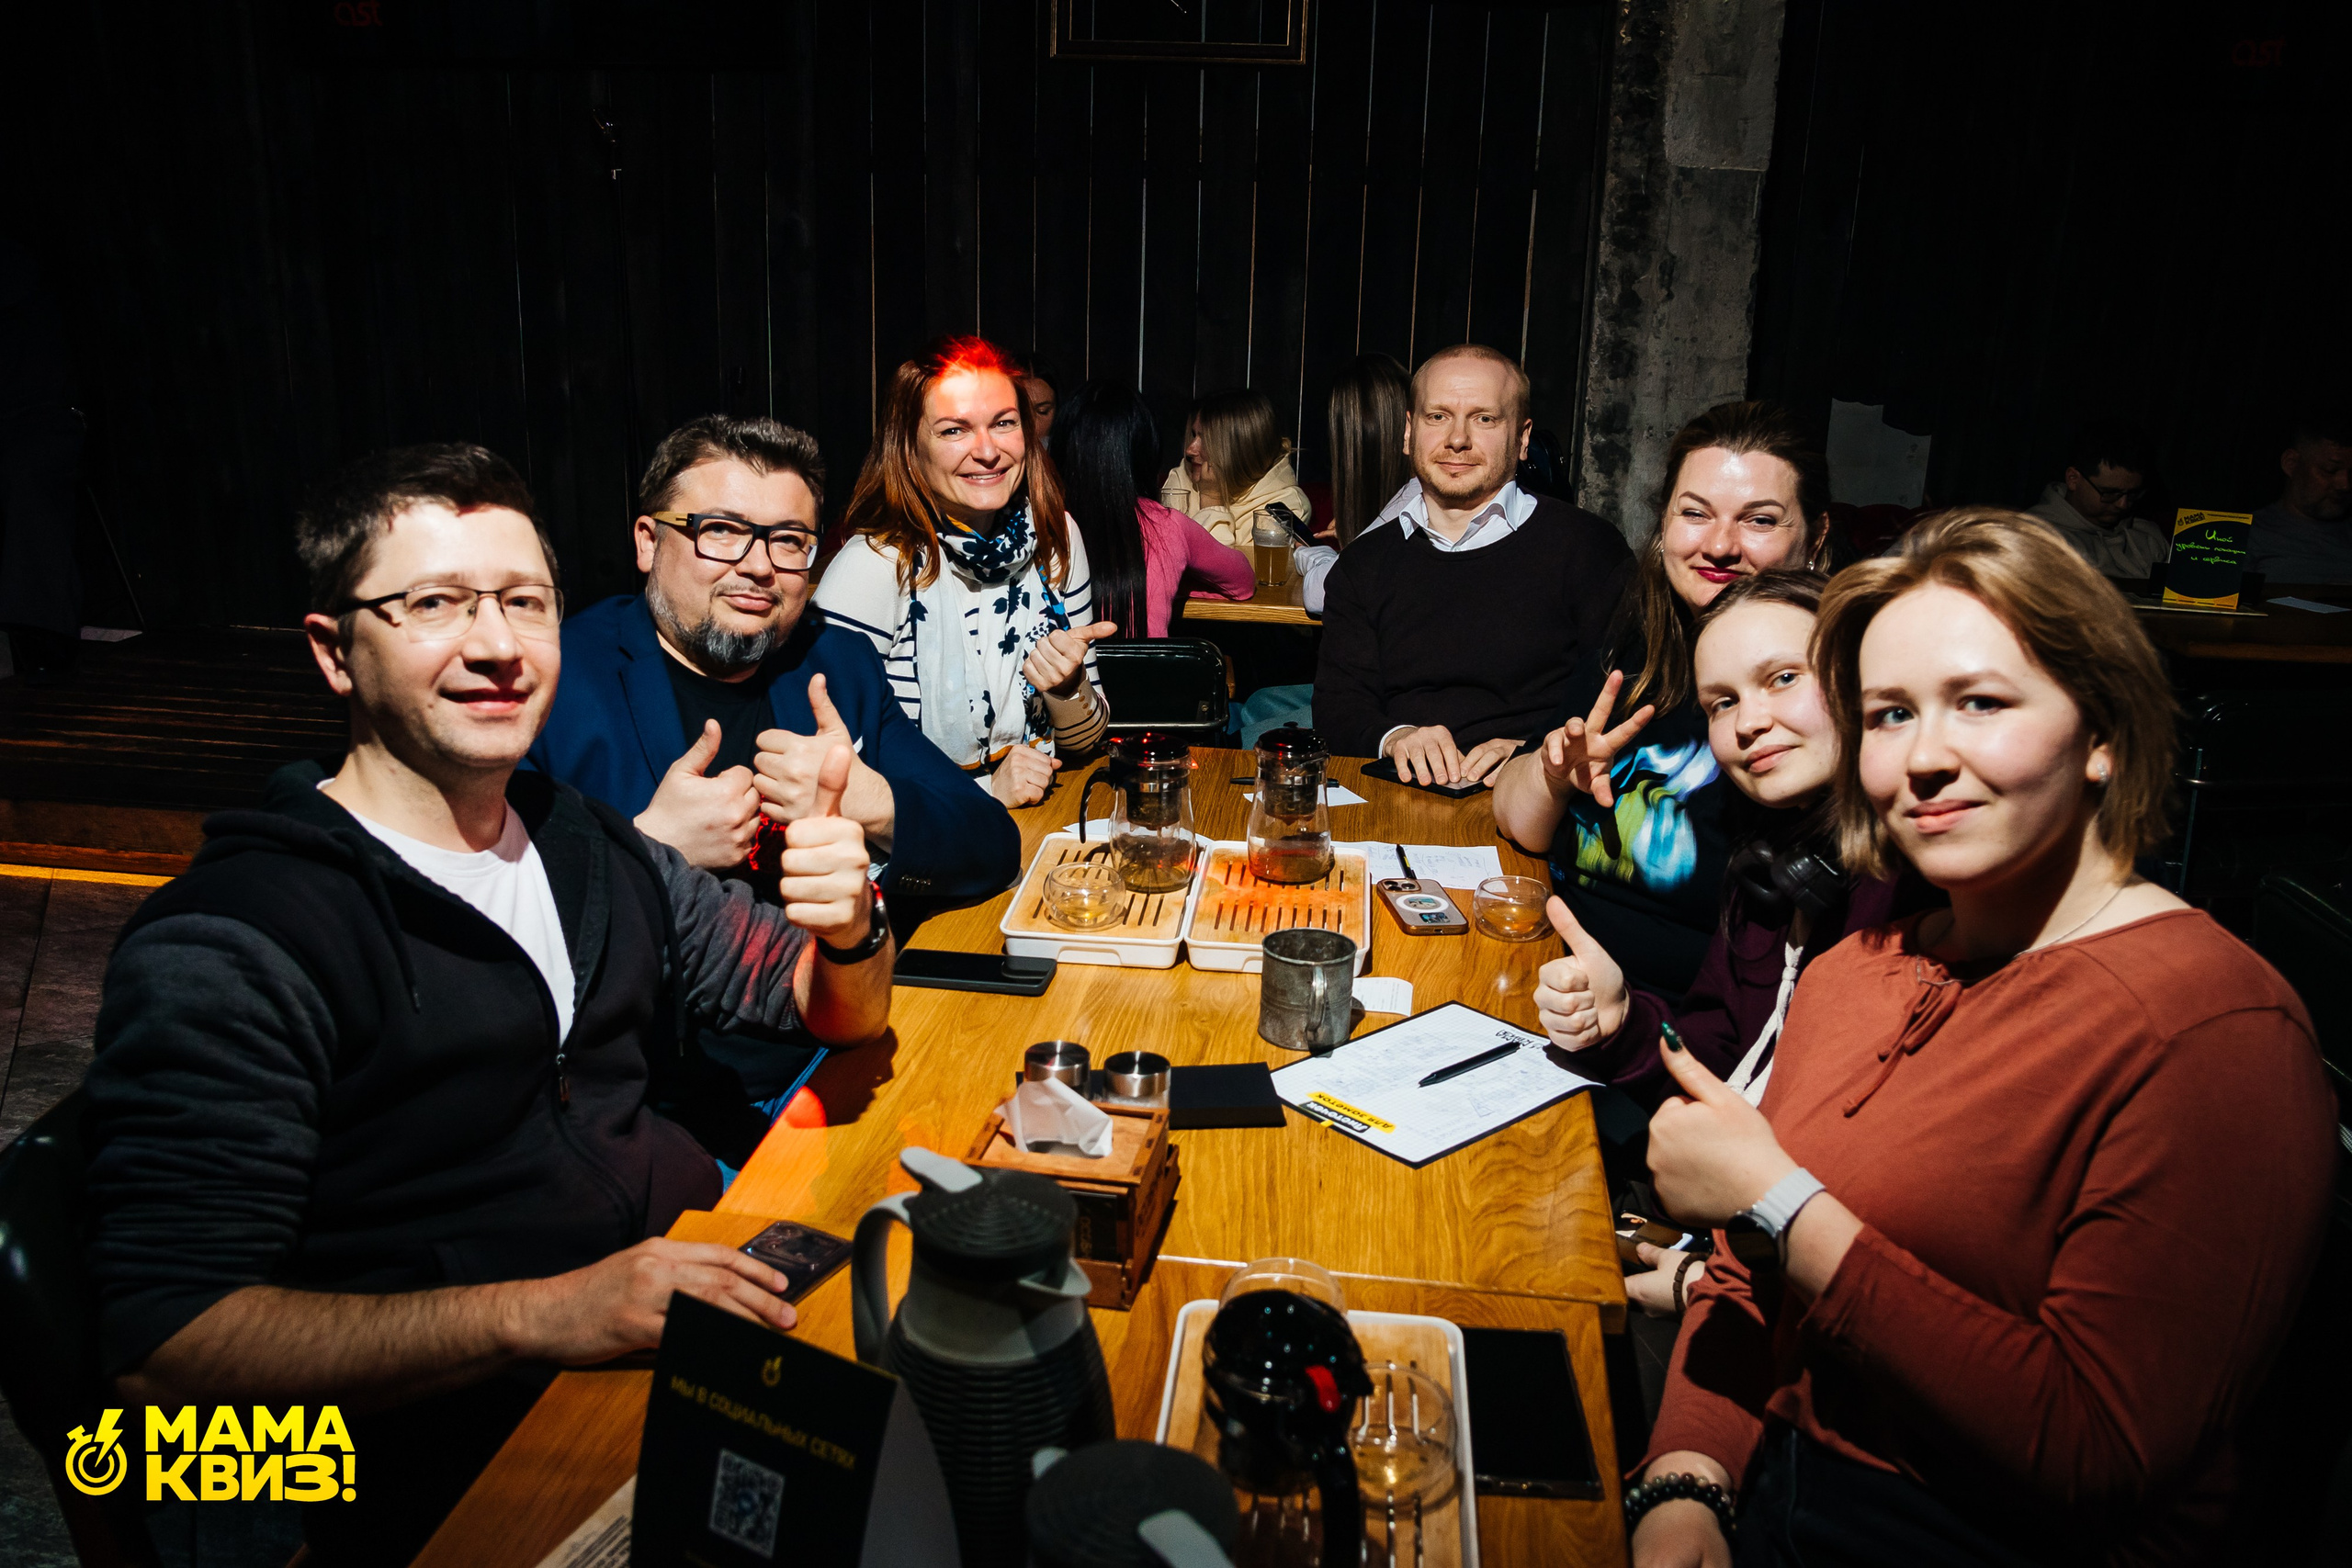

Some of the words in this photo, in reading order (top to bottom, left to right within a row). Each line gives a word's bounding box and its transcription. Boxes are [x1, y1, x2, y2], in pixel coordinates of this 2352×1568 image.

[2205, 529, 2233, 543] Иной
[670, 1374, 695, 1400] МЫ
[695, 1385, 708, 1404] В
[708, 1391, 808, 1449] СОЦИАЛЬНЫХ
